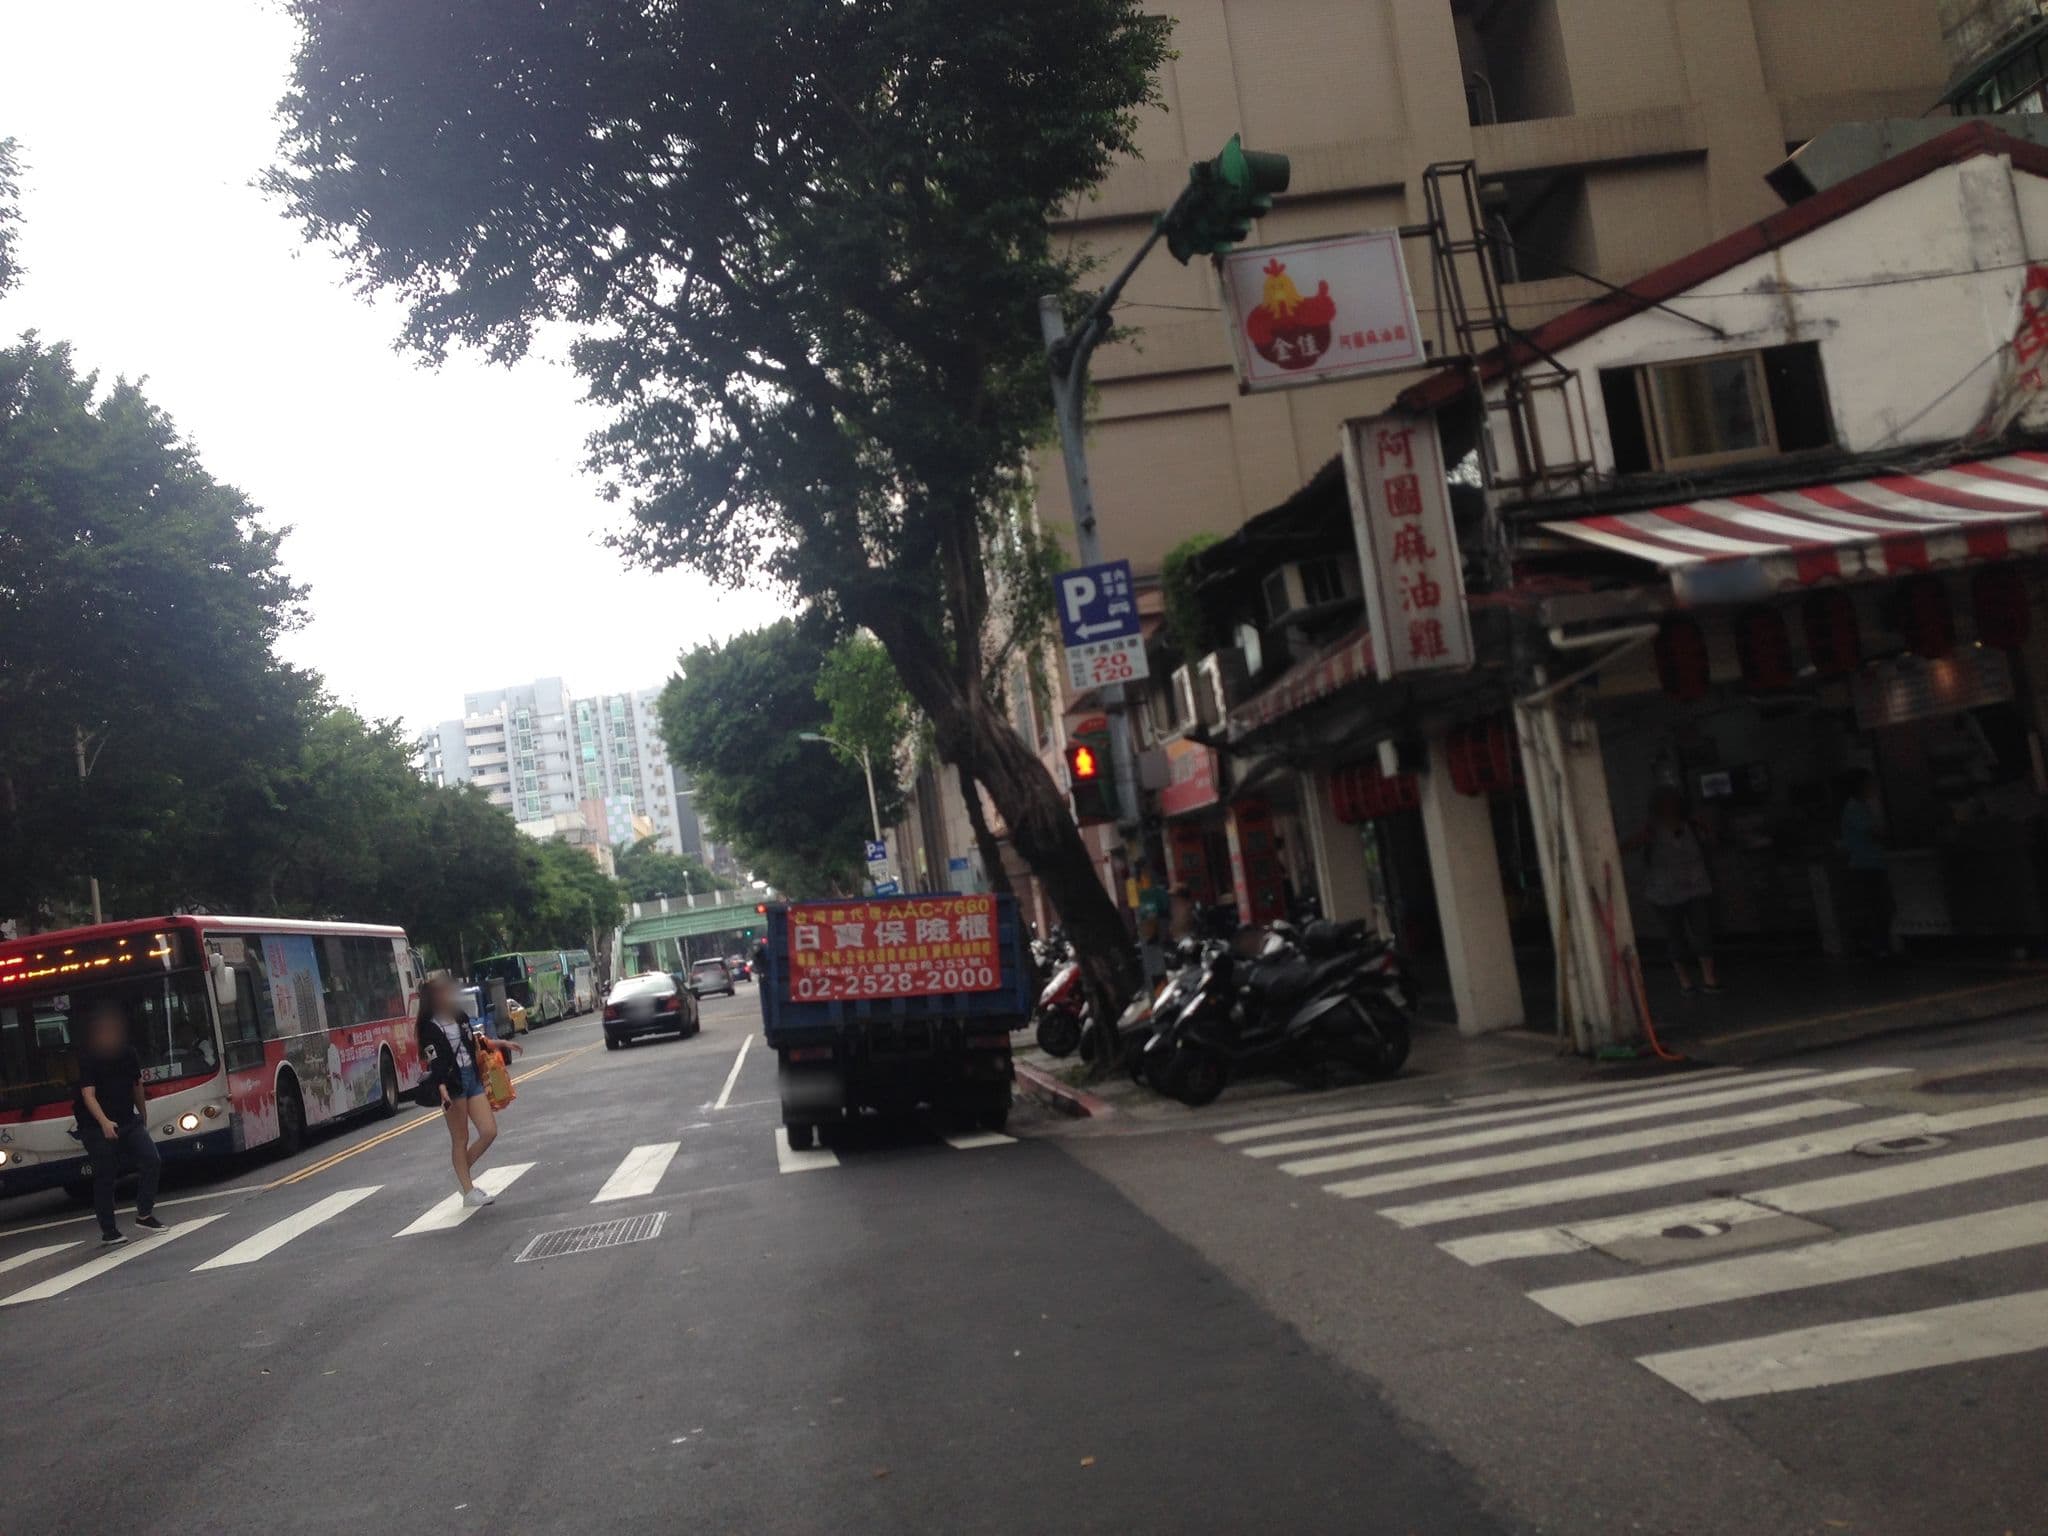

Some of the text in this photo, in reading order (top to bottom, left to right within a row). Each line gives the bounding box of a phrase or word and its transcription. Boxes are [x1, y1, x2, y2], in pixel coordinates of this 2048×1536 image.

[1063, 576, 1097, 622] P
[1094, 653, 1128, 669] 20
[1092, 666, 1133, 682] 120
[798, 967, 993, 998] 02-2528-2000
